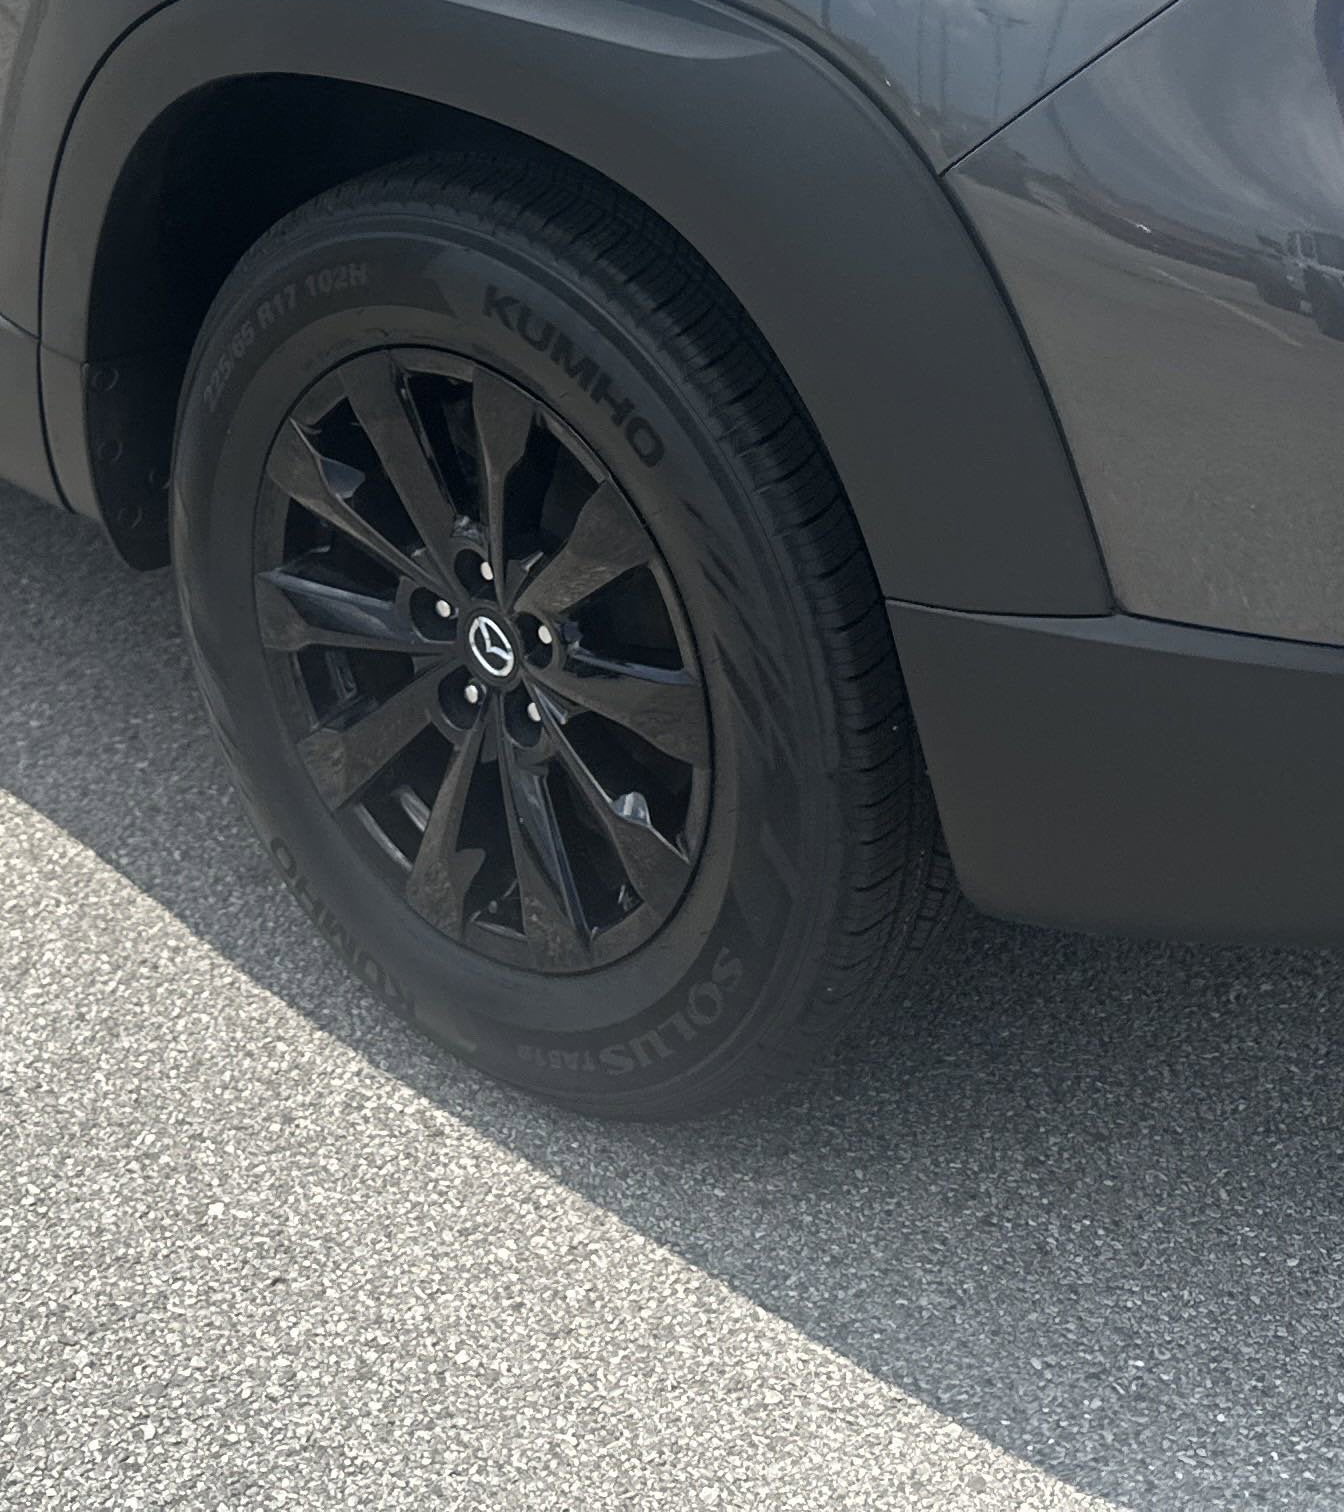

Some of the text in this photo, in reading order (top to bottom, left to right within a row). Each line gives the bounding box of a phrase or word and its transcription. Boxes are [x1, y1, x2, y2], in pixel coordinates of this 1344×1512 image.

[256, 283, 297, 330] R17
[303, 263, 369, 297] 102H
[481, 284, 666, 469] KUMHO
[599, 946, 745, 1076] SOLUS
